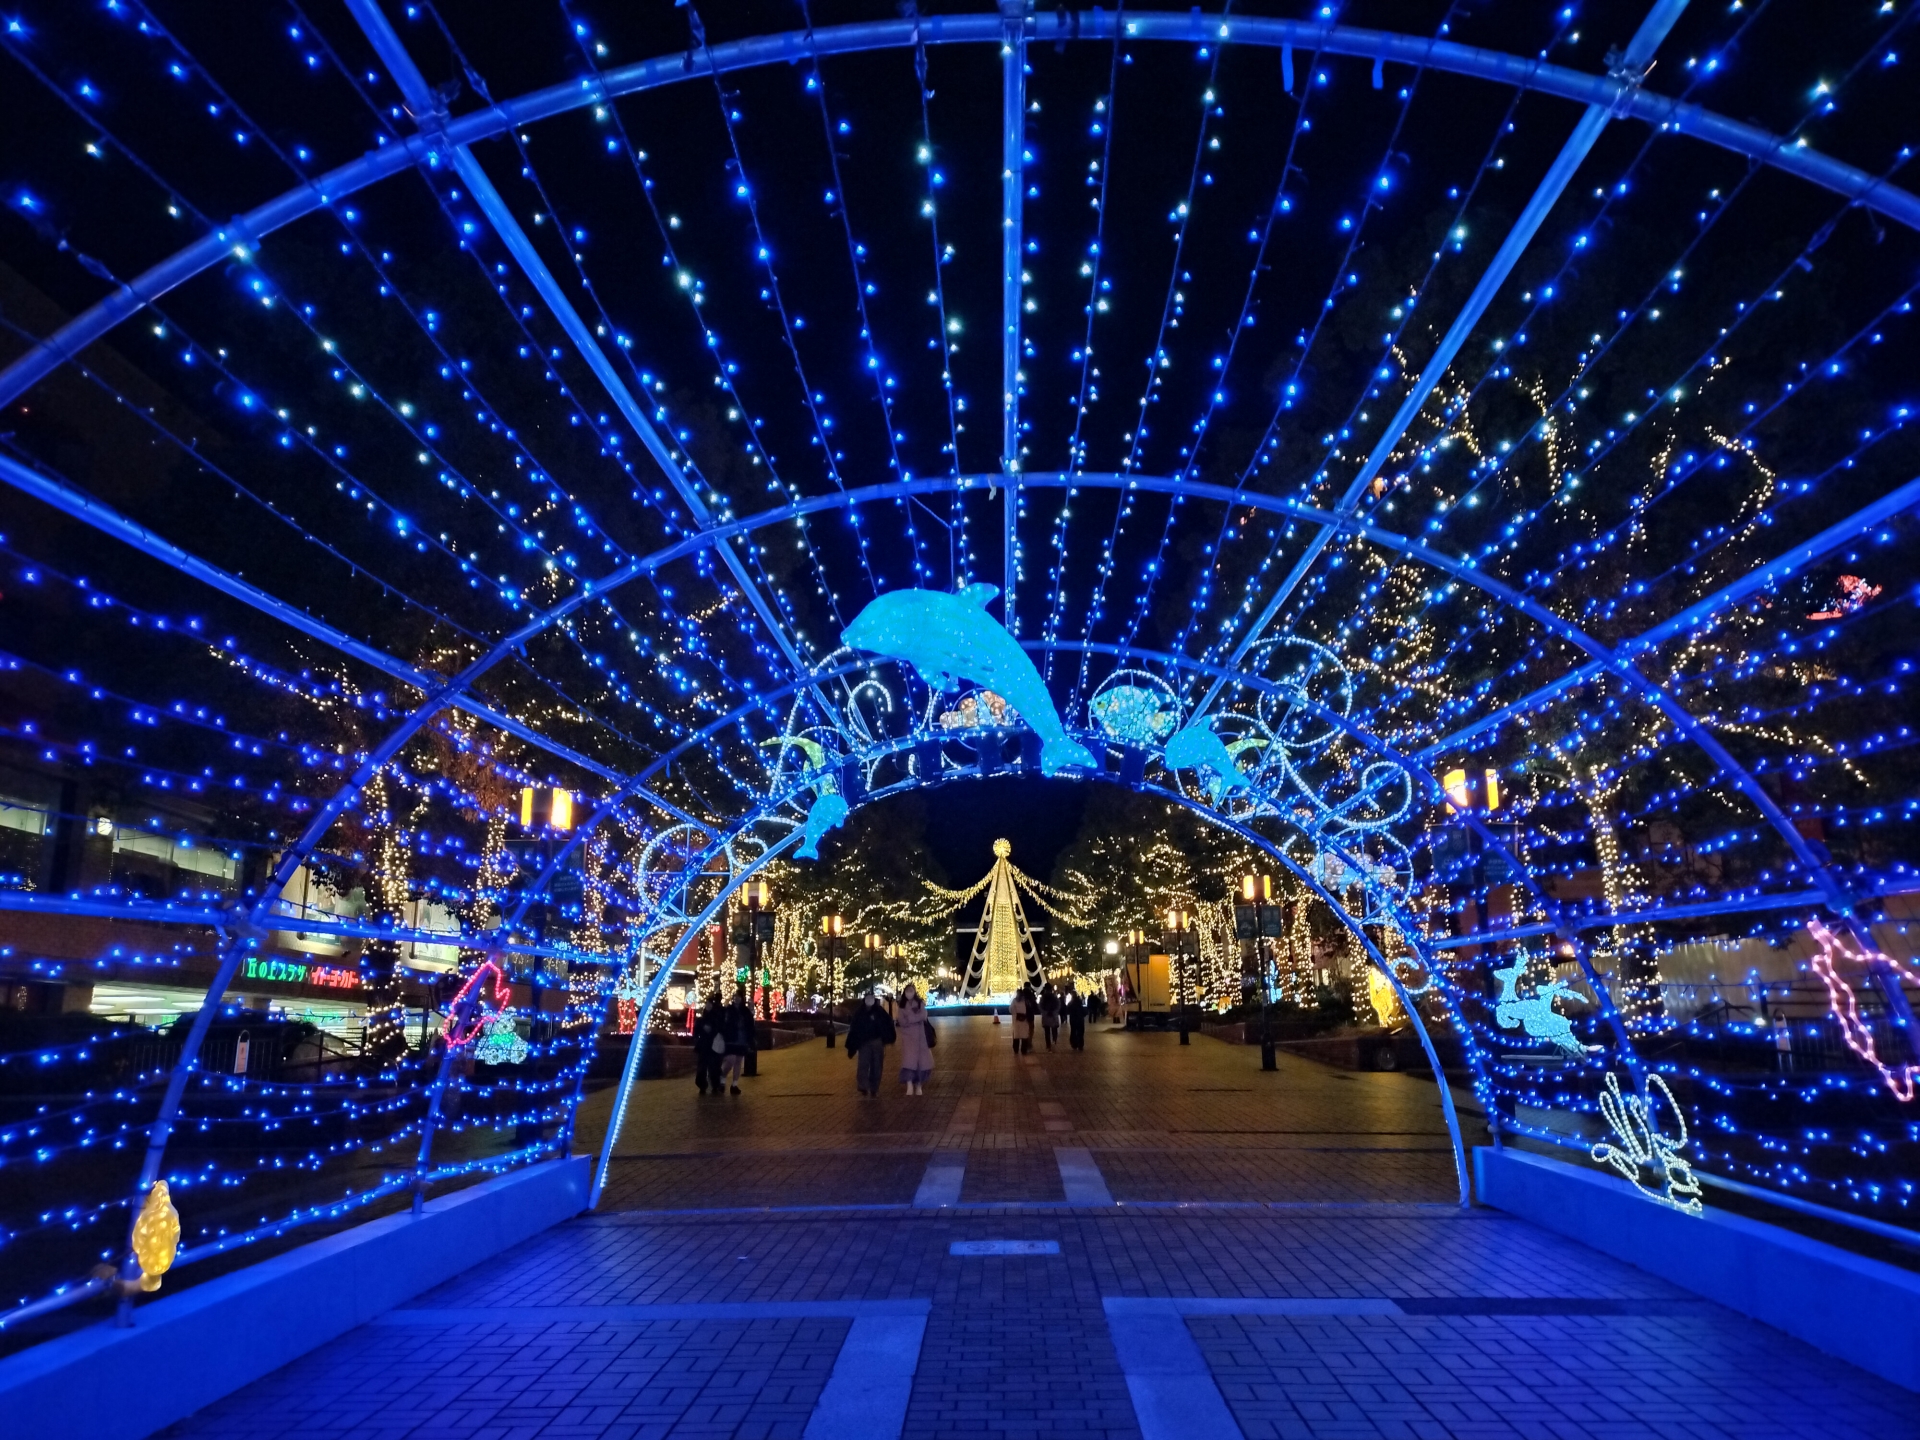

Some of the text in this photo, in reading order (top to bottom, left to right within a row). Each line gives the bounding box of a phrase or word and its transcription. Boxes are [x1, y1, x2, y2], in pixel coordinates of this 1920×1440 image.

[311, 966, 359, 989] イトーヨーカドー
